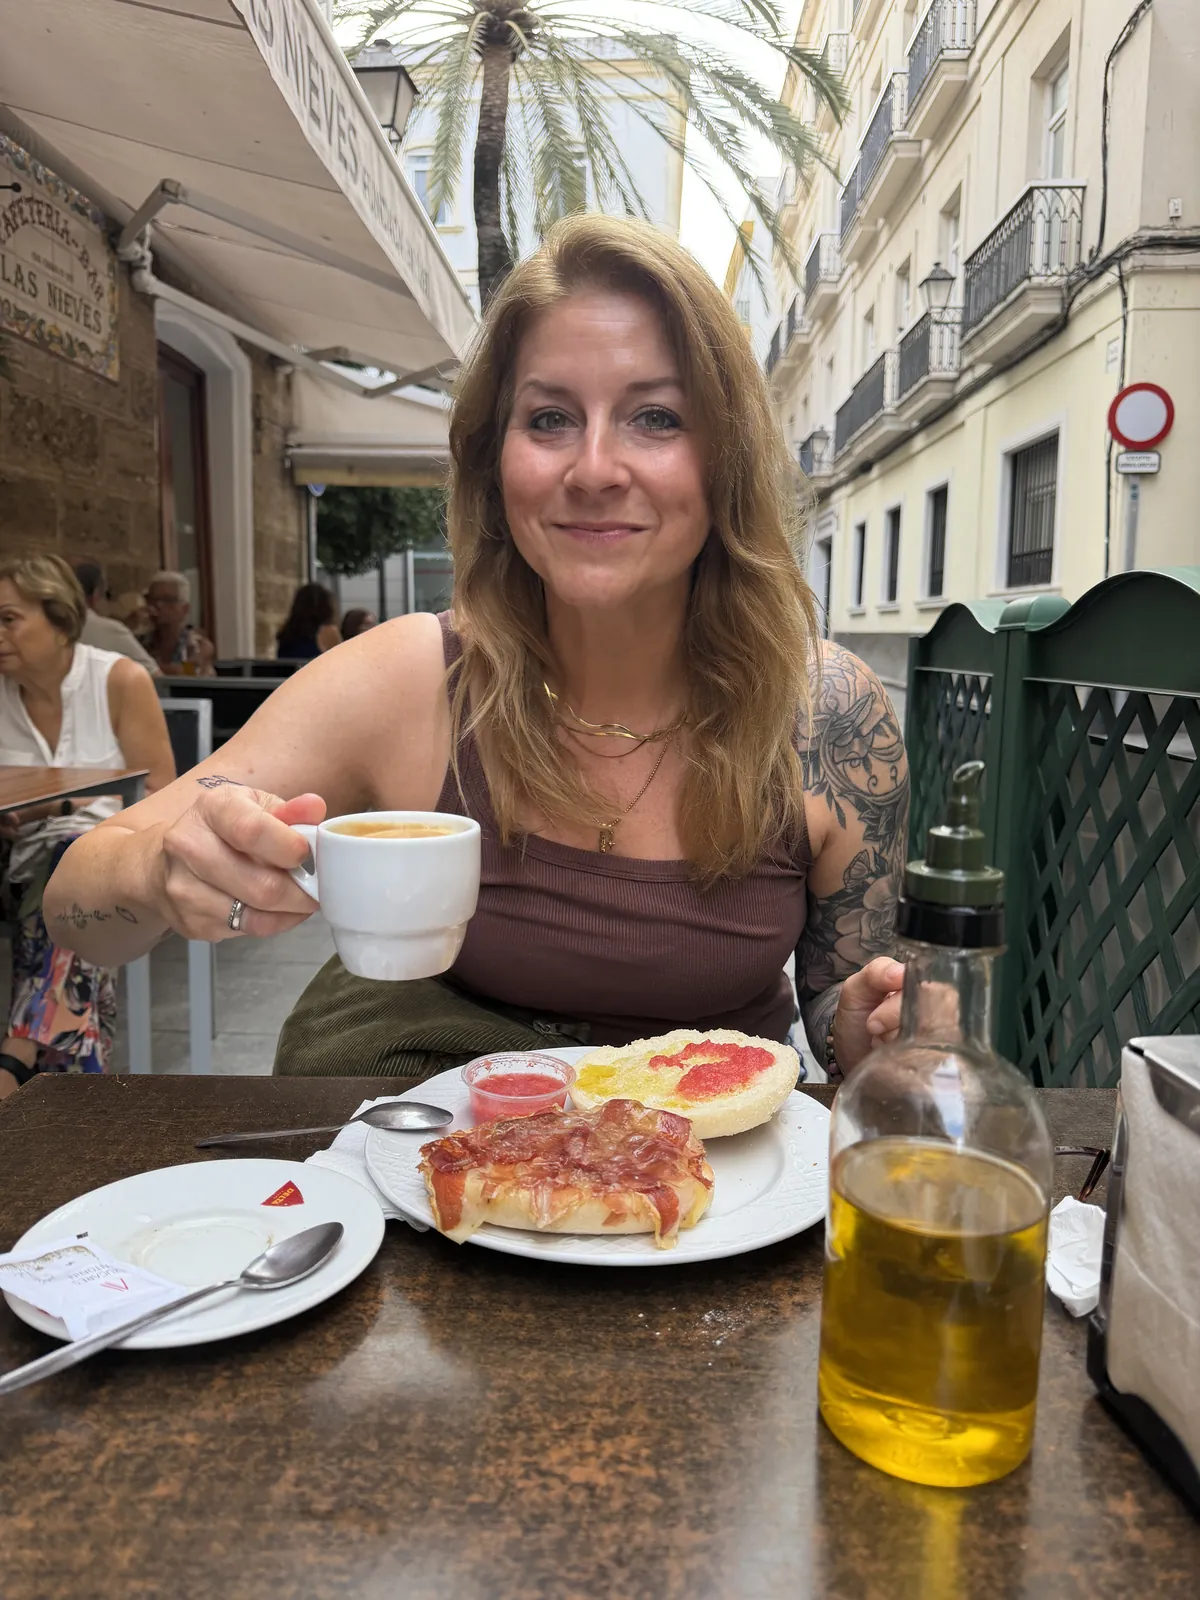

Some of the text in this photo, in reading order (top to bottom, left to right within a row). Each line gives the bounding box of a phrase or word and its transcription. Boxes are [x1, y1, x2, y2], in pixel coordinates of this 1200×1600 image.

[282, 0, 359, 185] NIEVES
[0, 254, 38, 298] LAS
[47, 282, 102, 334] NIEVES
[271, 1187, 294, 1204] DELTA
